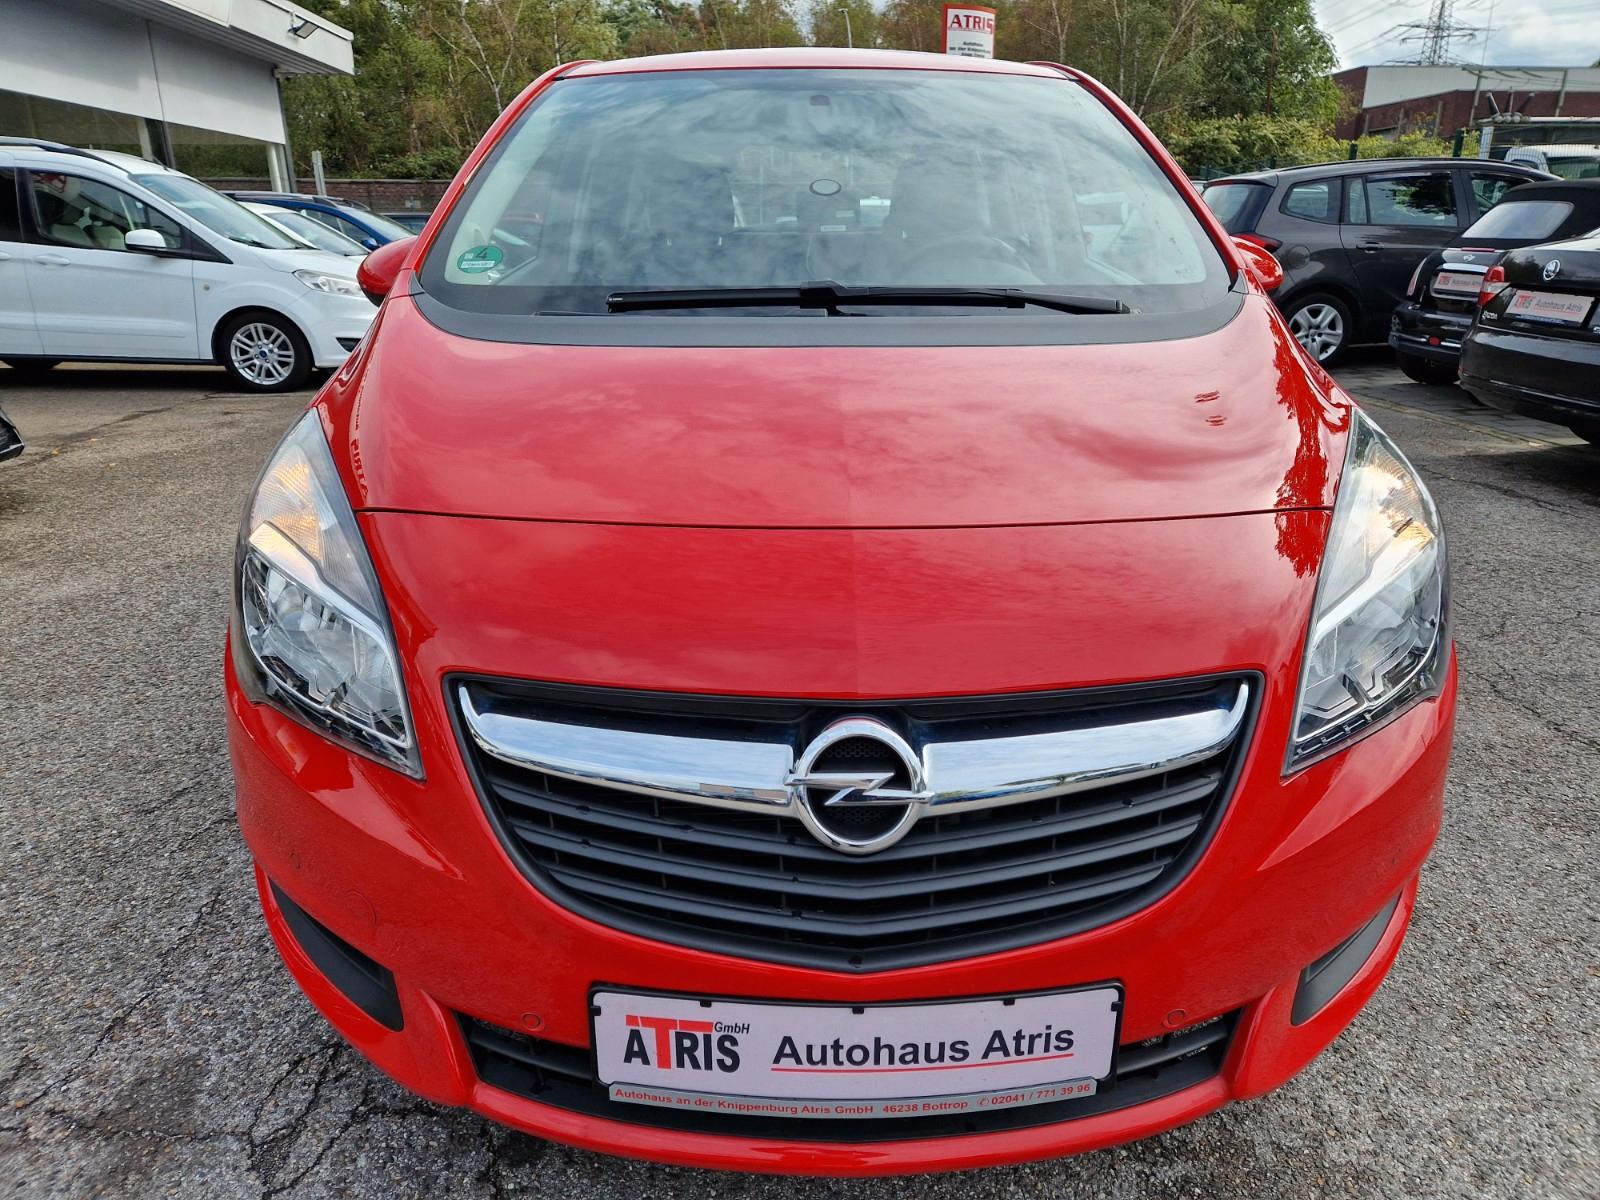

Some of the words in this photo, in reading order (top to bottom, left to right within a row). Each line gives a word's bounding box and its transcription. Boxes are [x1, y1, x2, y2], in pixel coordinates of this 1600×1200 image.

[950, 14, 994, 34] ATRIS
[476, 247, 488, 259] 4
[713, 1021, 750, 1036] GmbH
[623, 1014, 741, 1073] ATRIS
[772, 1035, 970, 1067] Autohaus
[981, 1024, 1075, 1060] Atris
[615, 1088, 673, 1105] Autohaus
[676, 1098, 690, 1106] an
[694, 1097, 714, 1109] der
[717, 1101, 799, 1116] Knippenburg
[801, 1104, 830, 1115] Atris
[834, 1104, 874, 1115] GmbH
[882, 1103, 919, 1114] 46238
[922, 1100, 969, 1113] Bottrop
[991, 1094, 1026, 1106] 02041
[1036, 1088, 1058, 1100] 771
[1060, 1086, 1074, 1097] 39
[1076, 1083, 1091, 1094] 96
